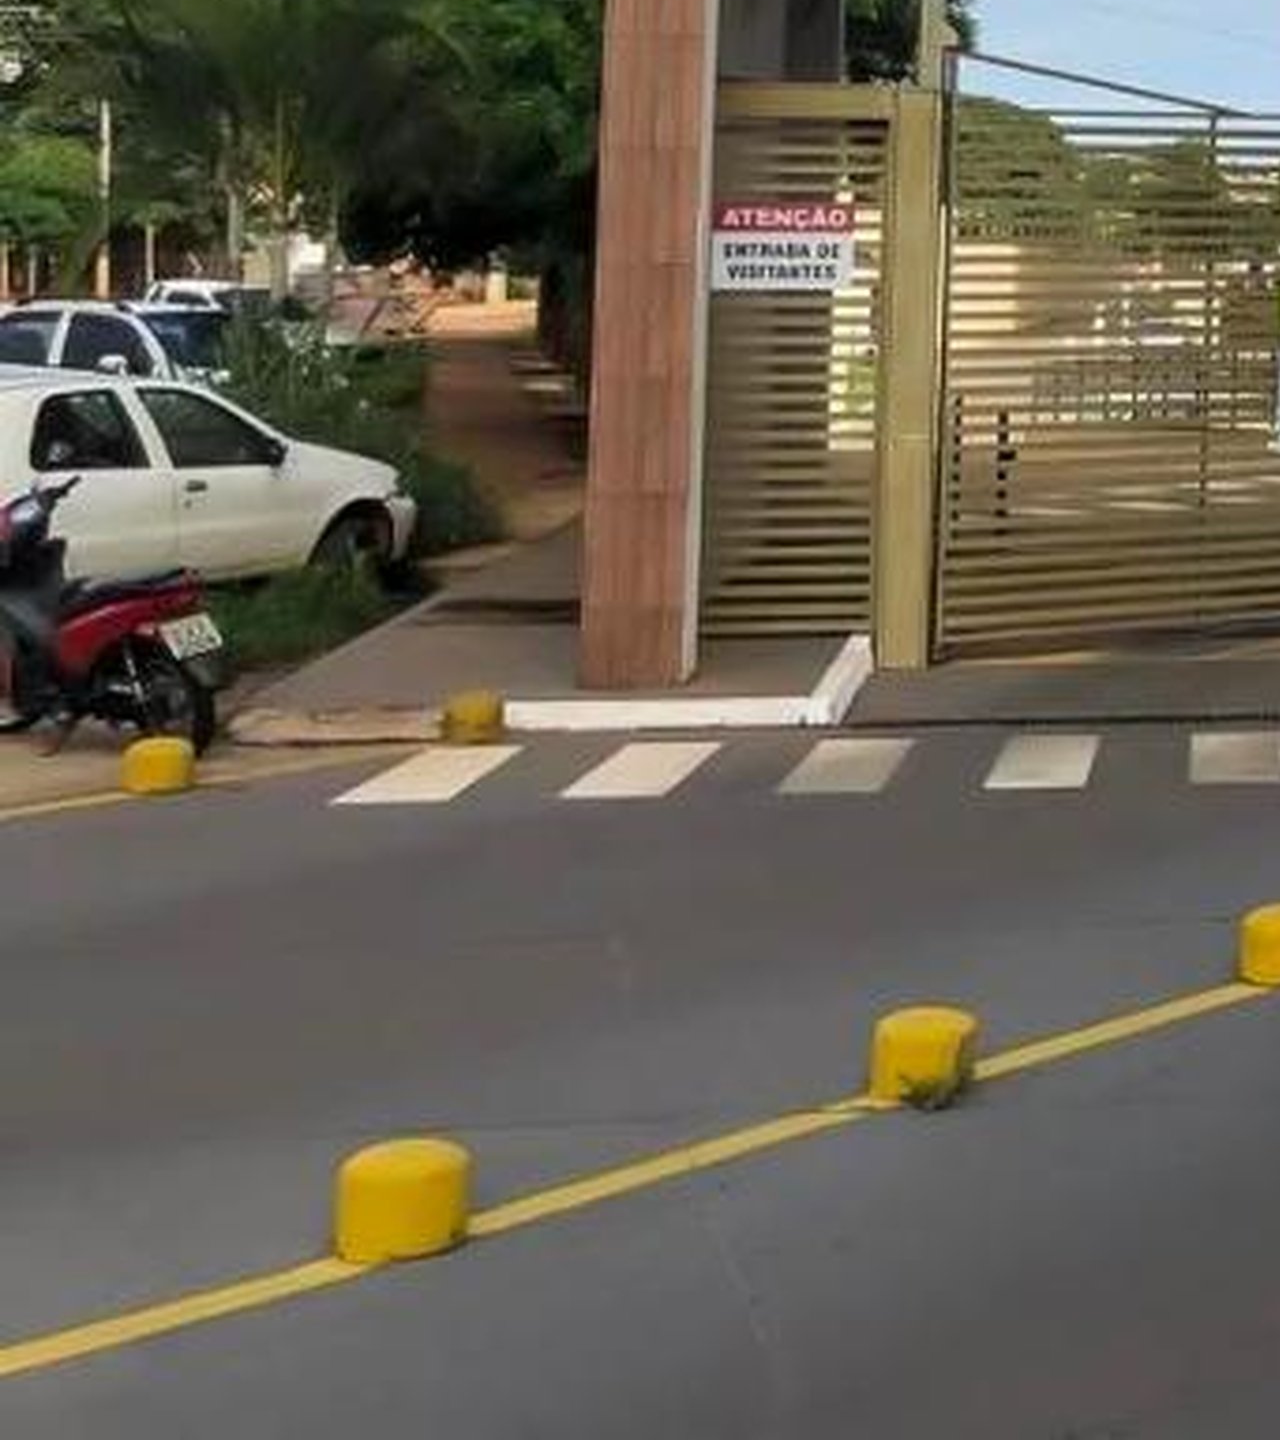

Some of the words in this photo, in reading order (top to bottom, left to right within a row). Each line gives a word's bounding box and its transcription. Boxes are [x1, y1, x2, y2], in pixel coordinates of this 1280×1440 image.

[723, 242, 809, 259] ENTRADA
[816, 242, 841, 259] DE
[727, 264, 837, 280] VISITANTES
